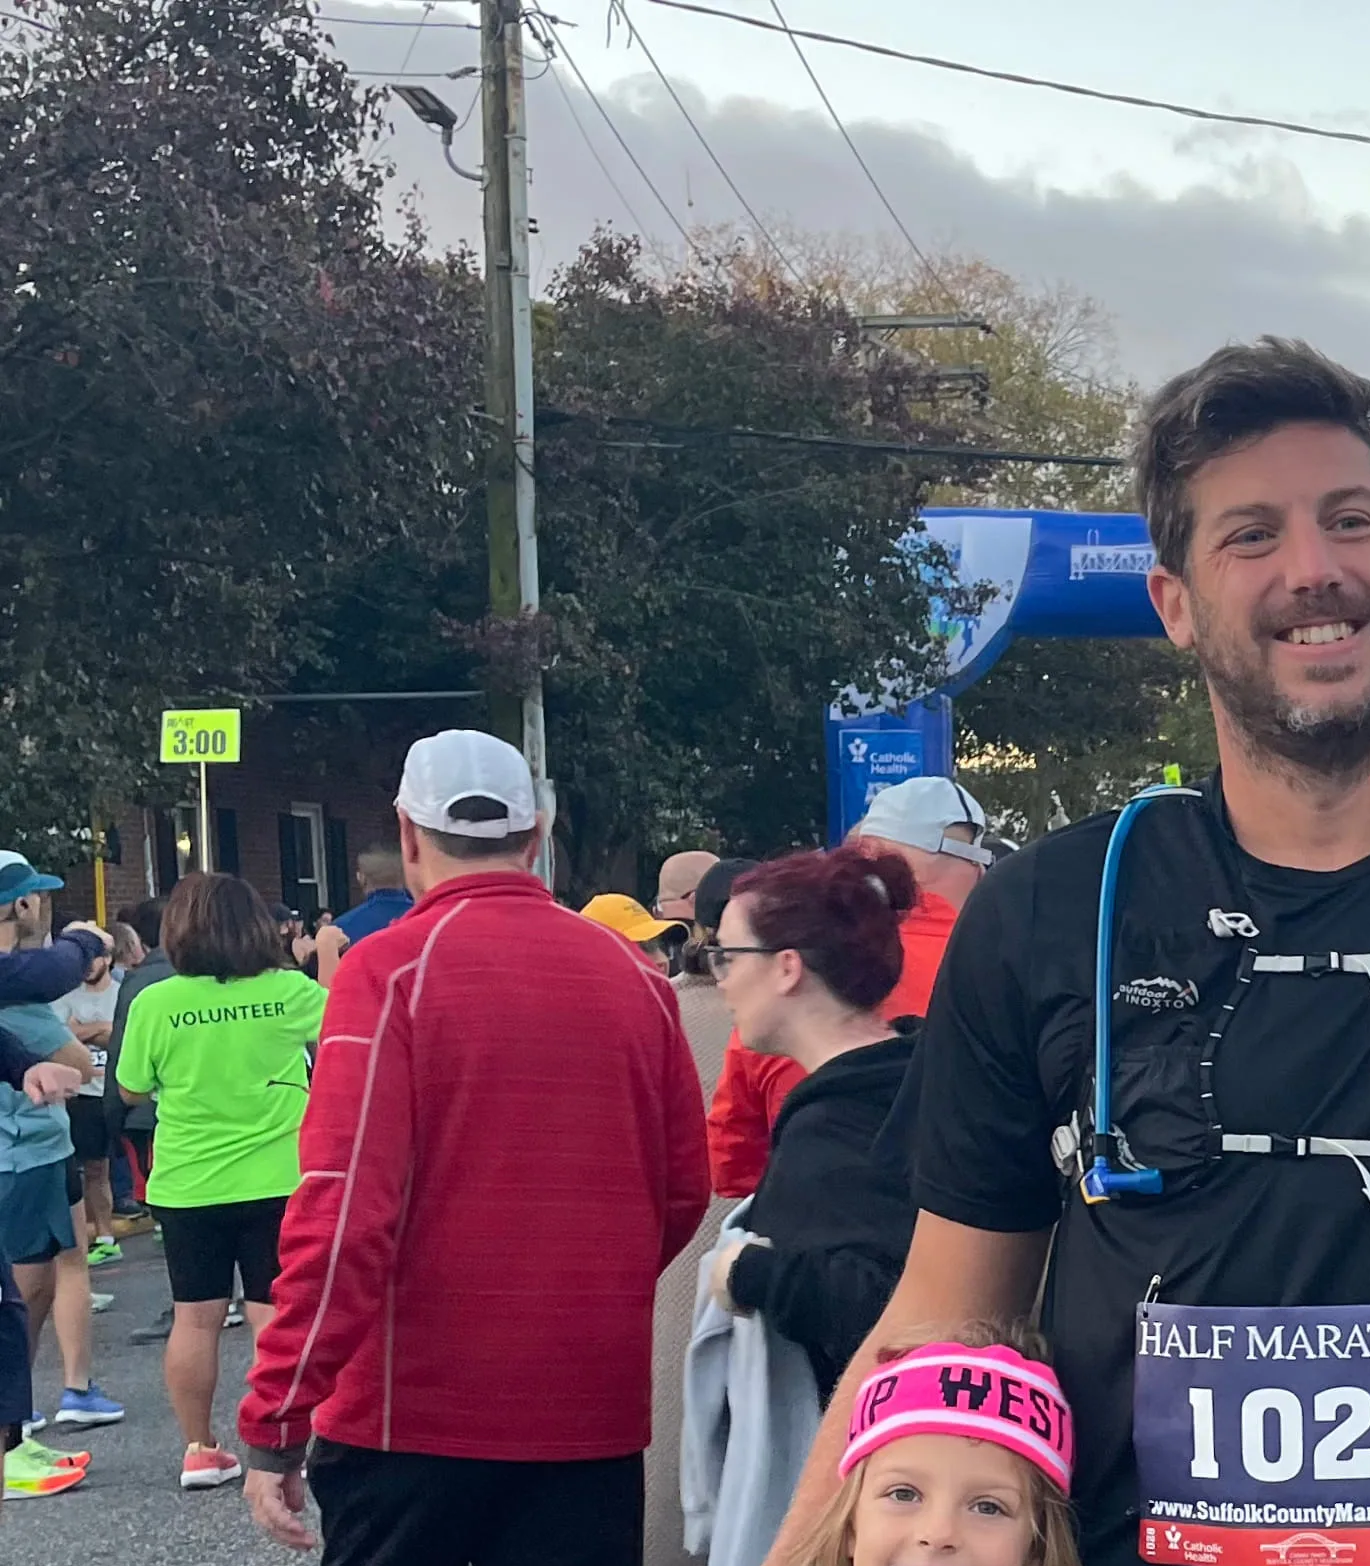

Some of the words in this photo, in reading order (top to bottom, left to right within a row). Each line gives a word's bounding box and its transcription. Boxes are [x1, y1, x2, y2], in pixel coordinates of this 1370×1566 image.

[173, 730, 226, 755] 3:00
[870, 752, 916, 764] Catholic
[870, 763, 908, 775] Health
[1119, 984, 1169, 999] outdoor
[169, 1001, 285, 1029] VOLUNTEER
[1138, 1321, 1236, 1360] HALF
[938, 1366, 1066, 1452] WEST
[1183, 1541, 1224, 1554] Catholic
[1184, 1552, 1217, 1563] Health
